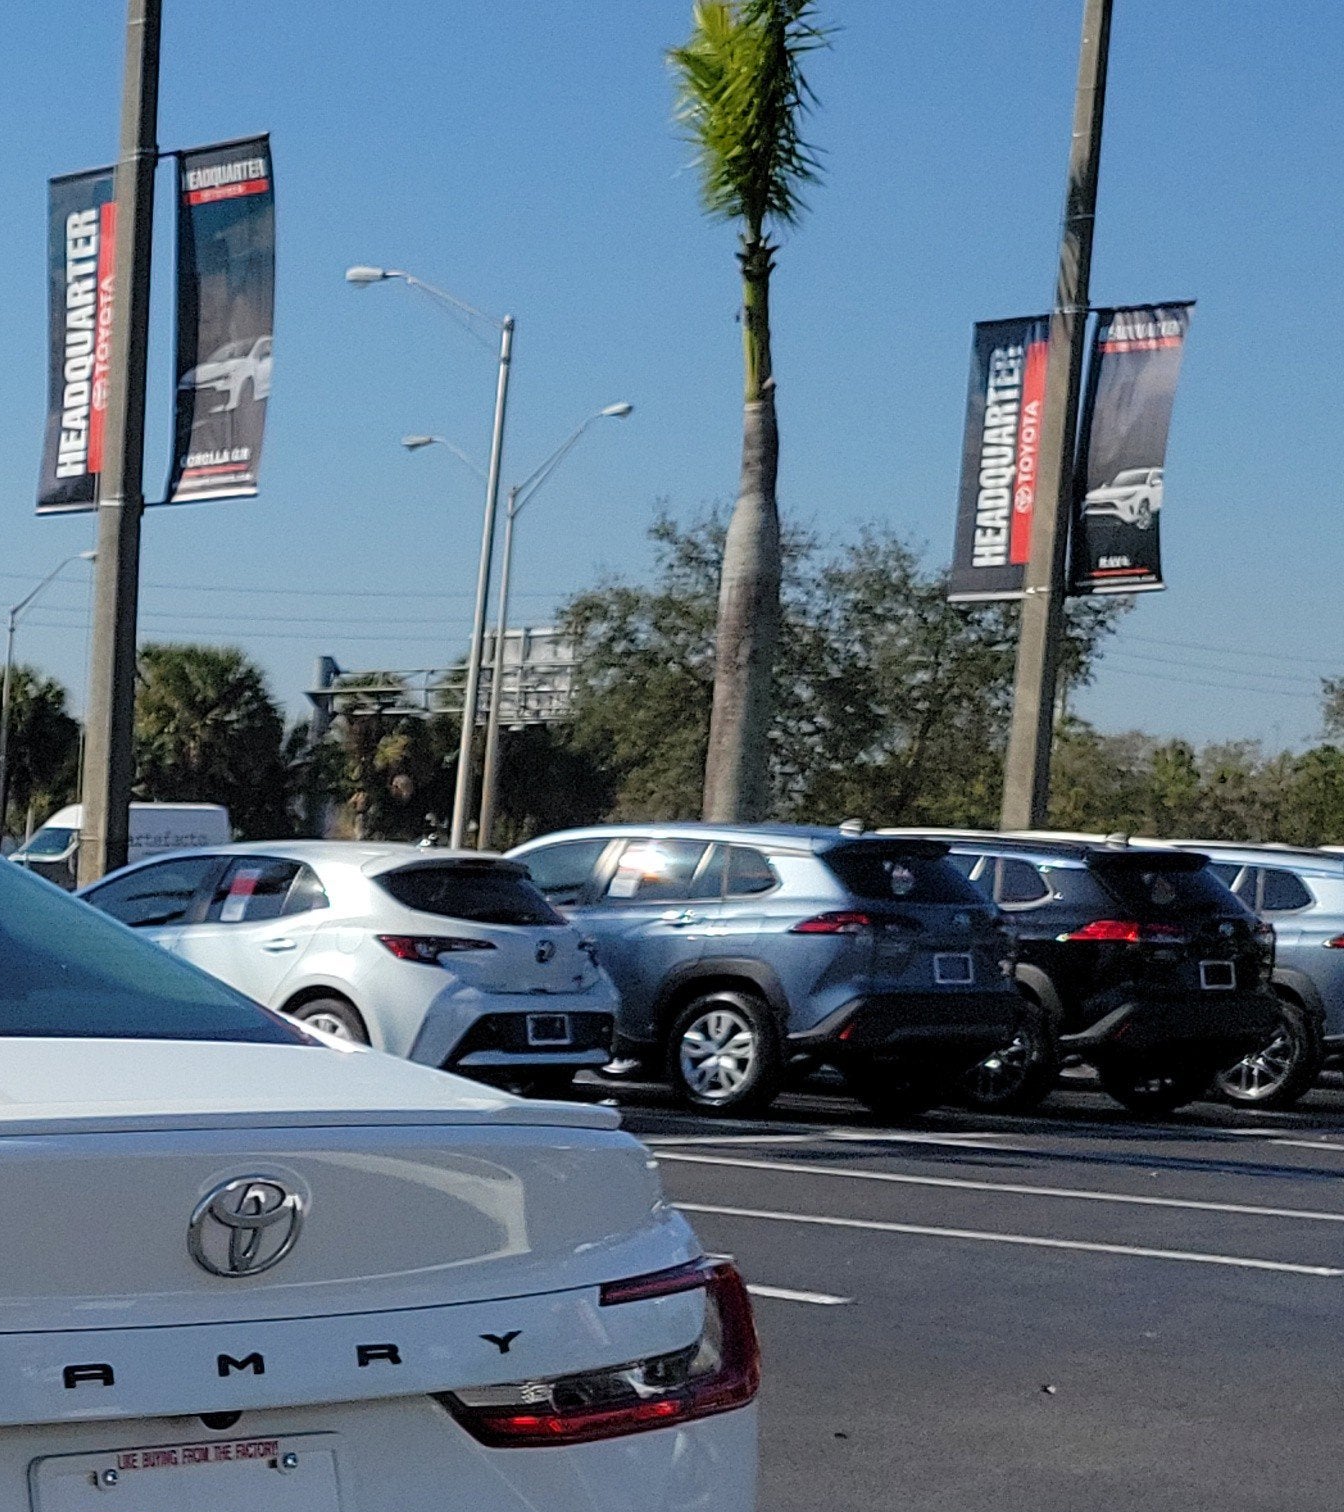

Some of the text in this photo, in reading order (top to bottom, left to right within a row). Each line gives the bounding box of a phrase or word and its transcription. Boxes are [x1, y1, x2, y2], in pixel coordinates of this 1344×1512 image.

[55, 208, 100, 479] HEADQUARTER
[95, 274, 115, 377] TOYOTA
[971, 345, 1022, 568] HEADQUARTER
[1016, 400, 1041, 485] TOYOTA
[214, 1443, 233, 1461] THE
